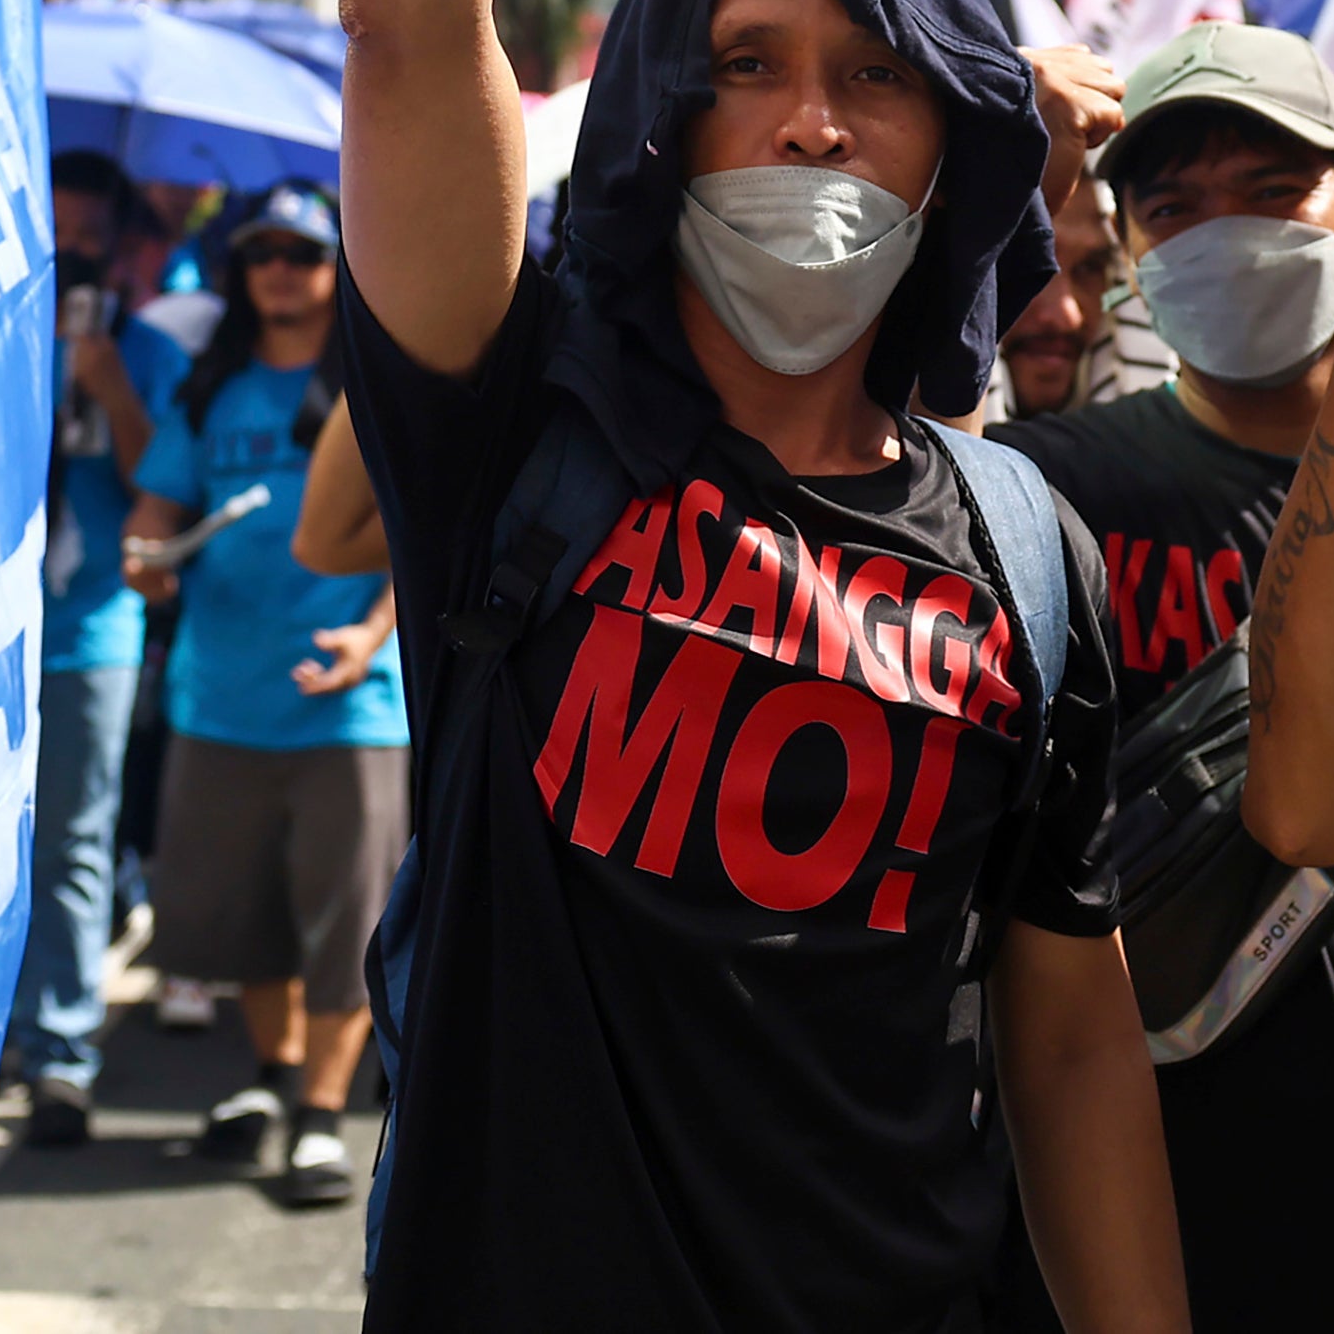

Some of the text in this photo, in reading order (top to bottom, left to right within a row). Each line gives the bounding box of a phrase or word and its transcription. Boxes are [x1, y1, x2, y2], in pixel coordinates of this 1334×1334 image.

[572, 478, 1022, 741] ASANGGA
[533, 602, 975, 934] MO!
[1254, 900, 1302, 962] SPORT
